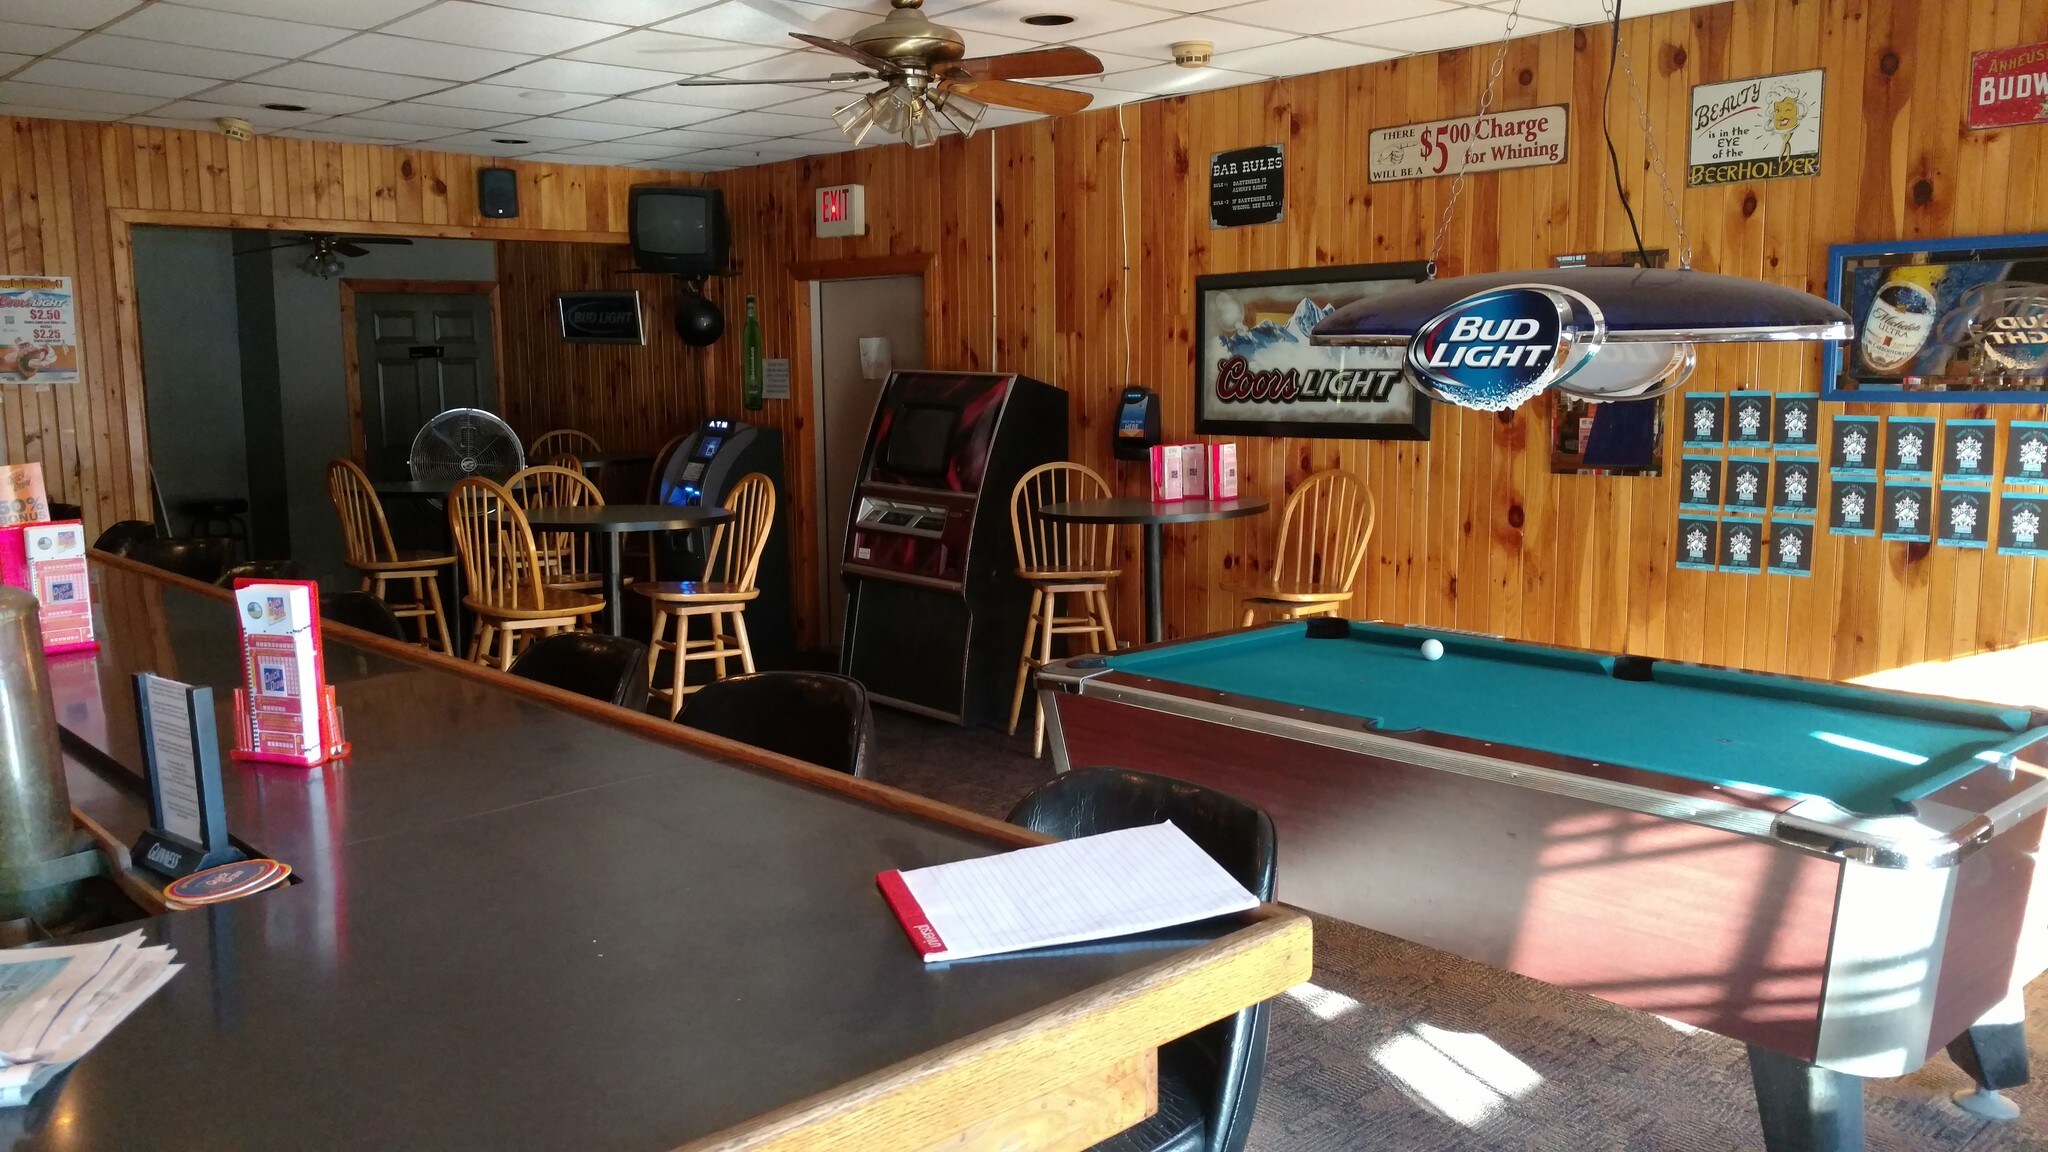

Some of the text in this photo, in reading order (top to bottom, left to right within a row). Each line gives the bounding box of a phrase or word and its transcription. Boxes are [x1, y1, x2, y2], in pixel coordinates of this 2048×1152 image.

[1988, 49, 2048, 73] ANHEUS
[1695, 81, 1761, 131] BEAUTY
[1382, 129, 1415, 141] THERE
[1474, 117, 1549, 142] Charge
[1708, 127, 1750, 139] is in the
[1717, 137, 1740, 148] EYE
[1465, 142, 1559, 164] for Whining
[1712, 149, 1744, 159] of the
[1213, 157, 1283, 177] BAR RULES
[1373, 167, 1423, 180] WILL BE A
[1691, 158, 1816, 185] BEERHOLDER
[822, 189, 849, 223] EXIT
[32, 299, 67, 308] LIGHT
[30, 309, 60, 320] $2.50
[574, 311, 633, 324] BUD LIGHT
[33, 329, 60, 339] $2.25
[1449, 316, 1541, 343] BUD
[1878, 323, 1908, 338] ULTRA
[1428, 343, 1552, 368] LIGHT
[1216, 355, 1400, 403] Coors LIGHT
[709, 420, 728, 429] ATM
[0, 496, 45, 516] 50%
[0, 511, 47, 526] BONUS
[265, 669, 281, 684] Quick
[271, 678, 285, 692] Draw
[148, 842, 182, 869] GUINNESS
